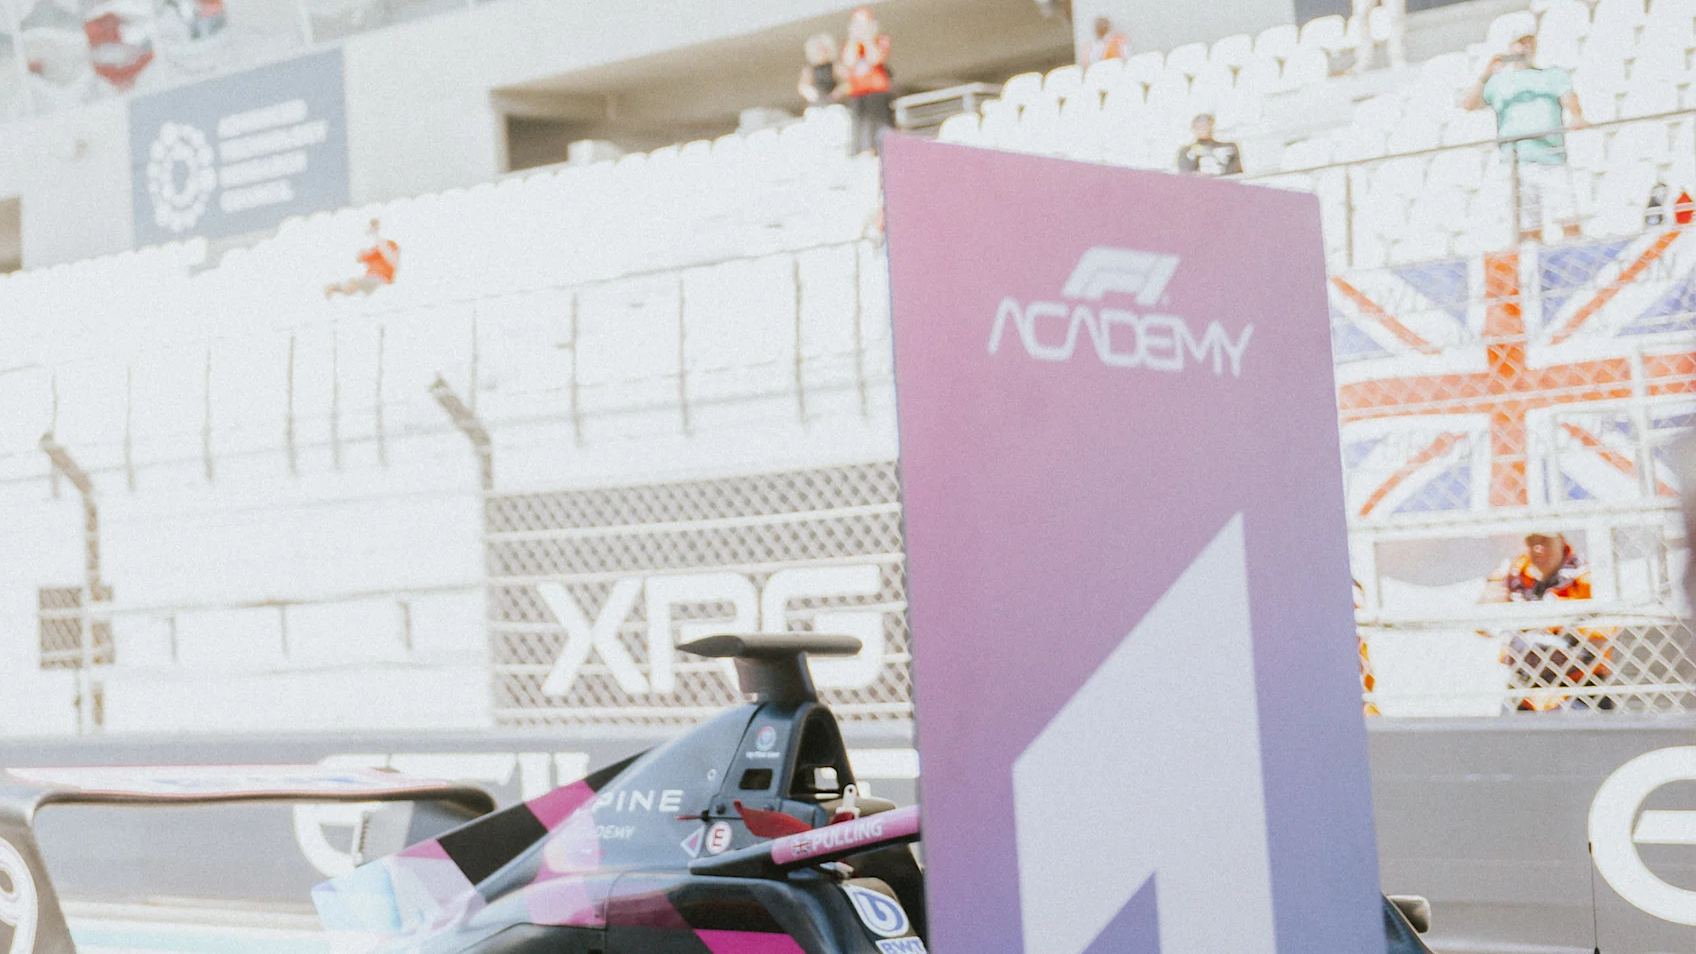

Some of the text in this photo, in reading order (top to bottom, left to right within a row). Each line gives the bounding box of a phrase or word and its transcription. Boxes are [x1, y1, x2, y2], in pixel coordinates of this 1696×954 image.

[987, 296, 1254, 377] ACADEMY
[1012, 511, 1278, 954] 1
[712, 828, 725, 847] E
[810, 818, 884, 851] PULLING
